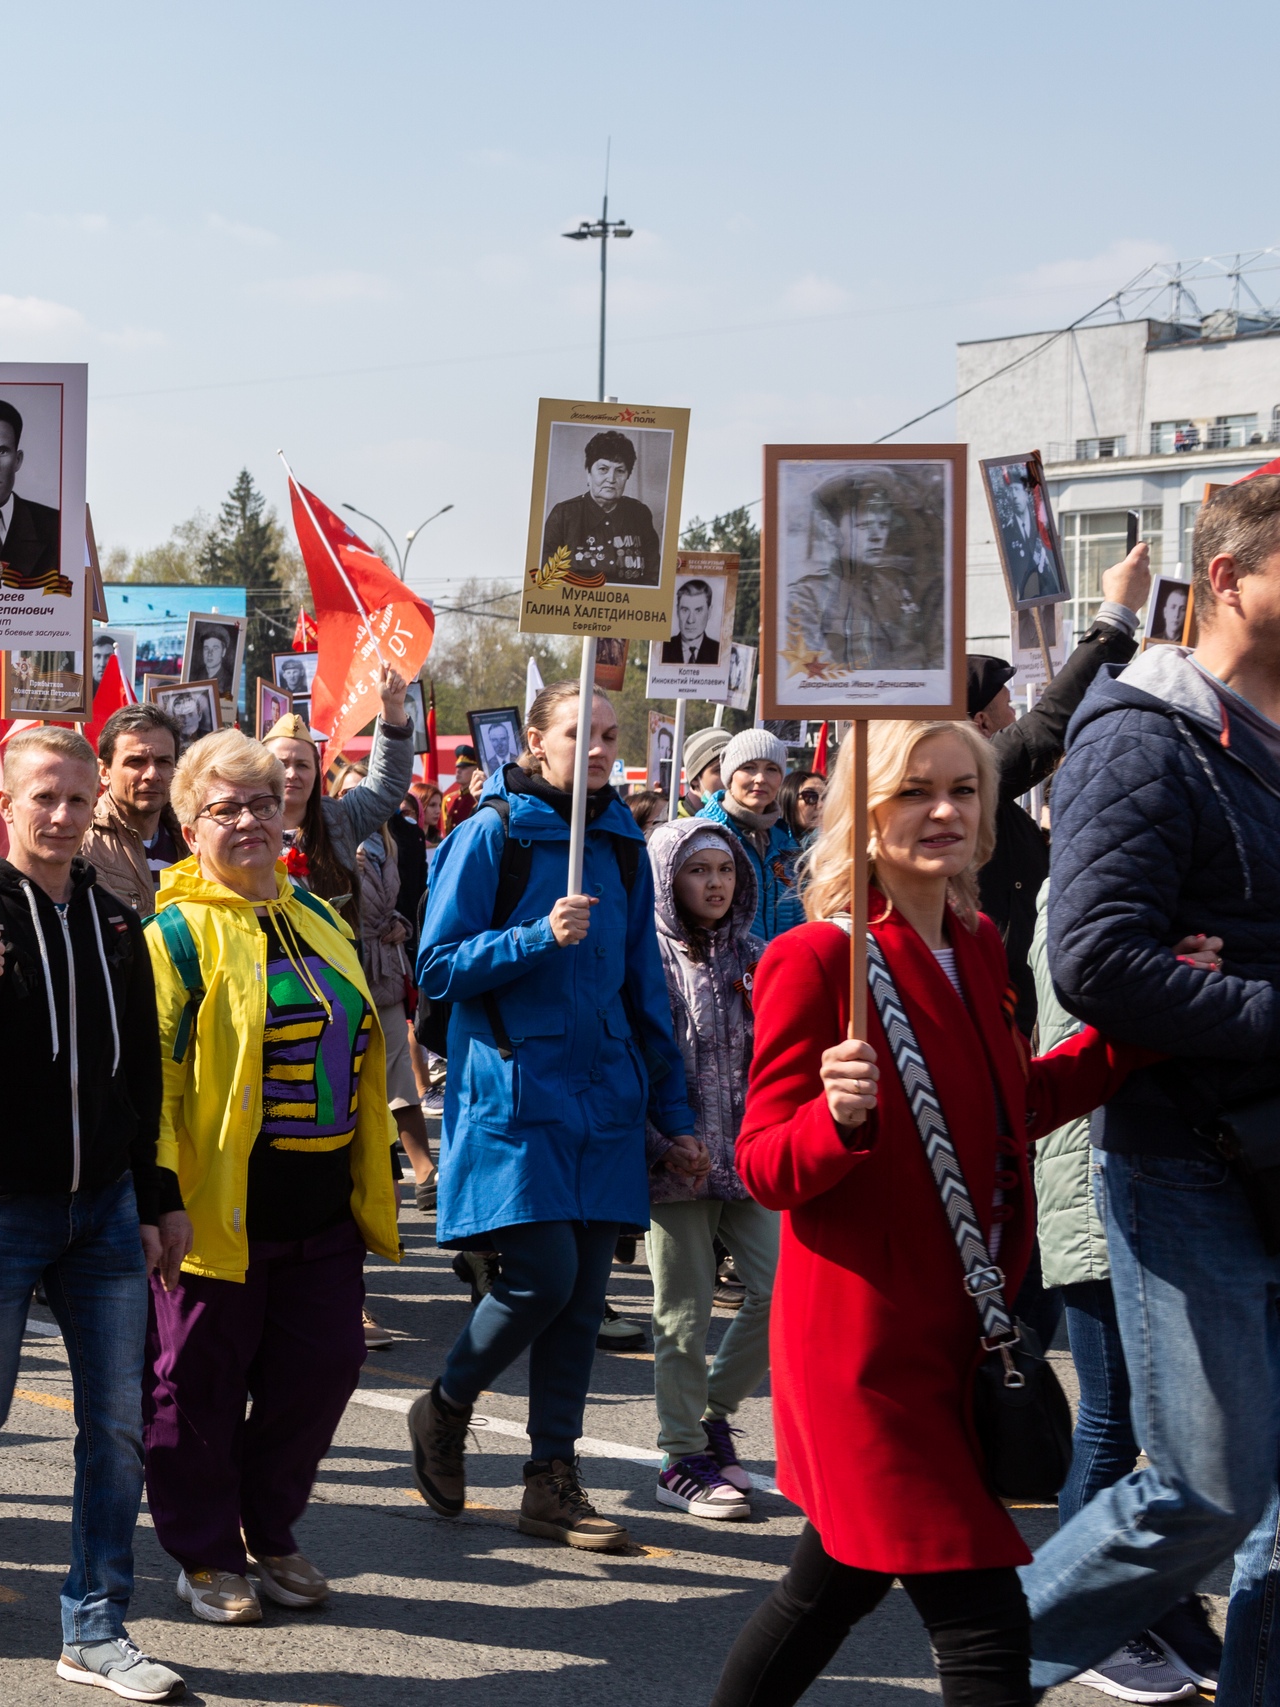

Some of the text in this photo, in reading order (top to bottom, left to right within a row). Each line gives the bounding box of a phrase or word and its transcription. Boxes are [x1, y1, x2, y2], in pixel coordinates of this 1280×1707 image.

[561, 586, 630, 604] МУРАШОВА
[525, 601, 667, 623] ГАЛИНА ХАЛЕТДИНОВНА
[572, 621, 612, 632] ЕФРЕЙТОР
[5, 628, 33, 637] боевые
[651, 676, 726, 686] Иннокентий Николаевич
